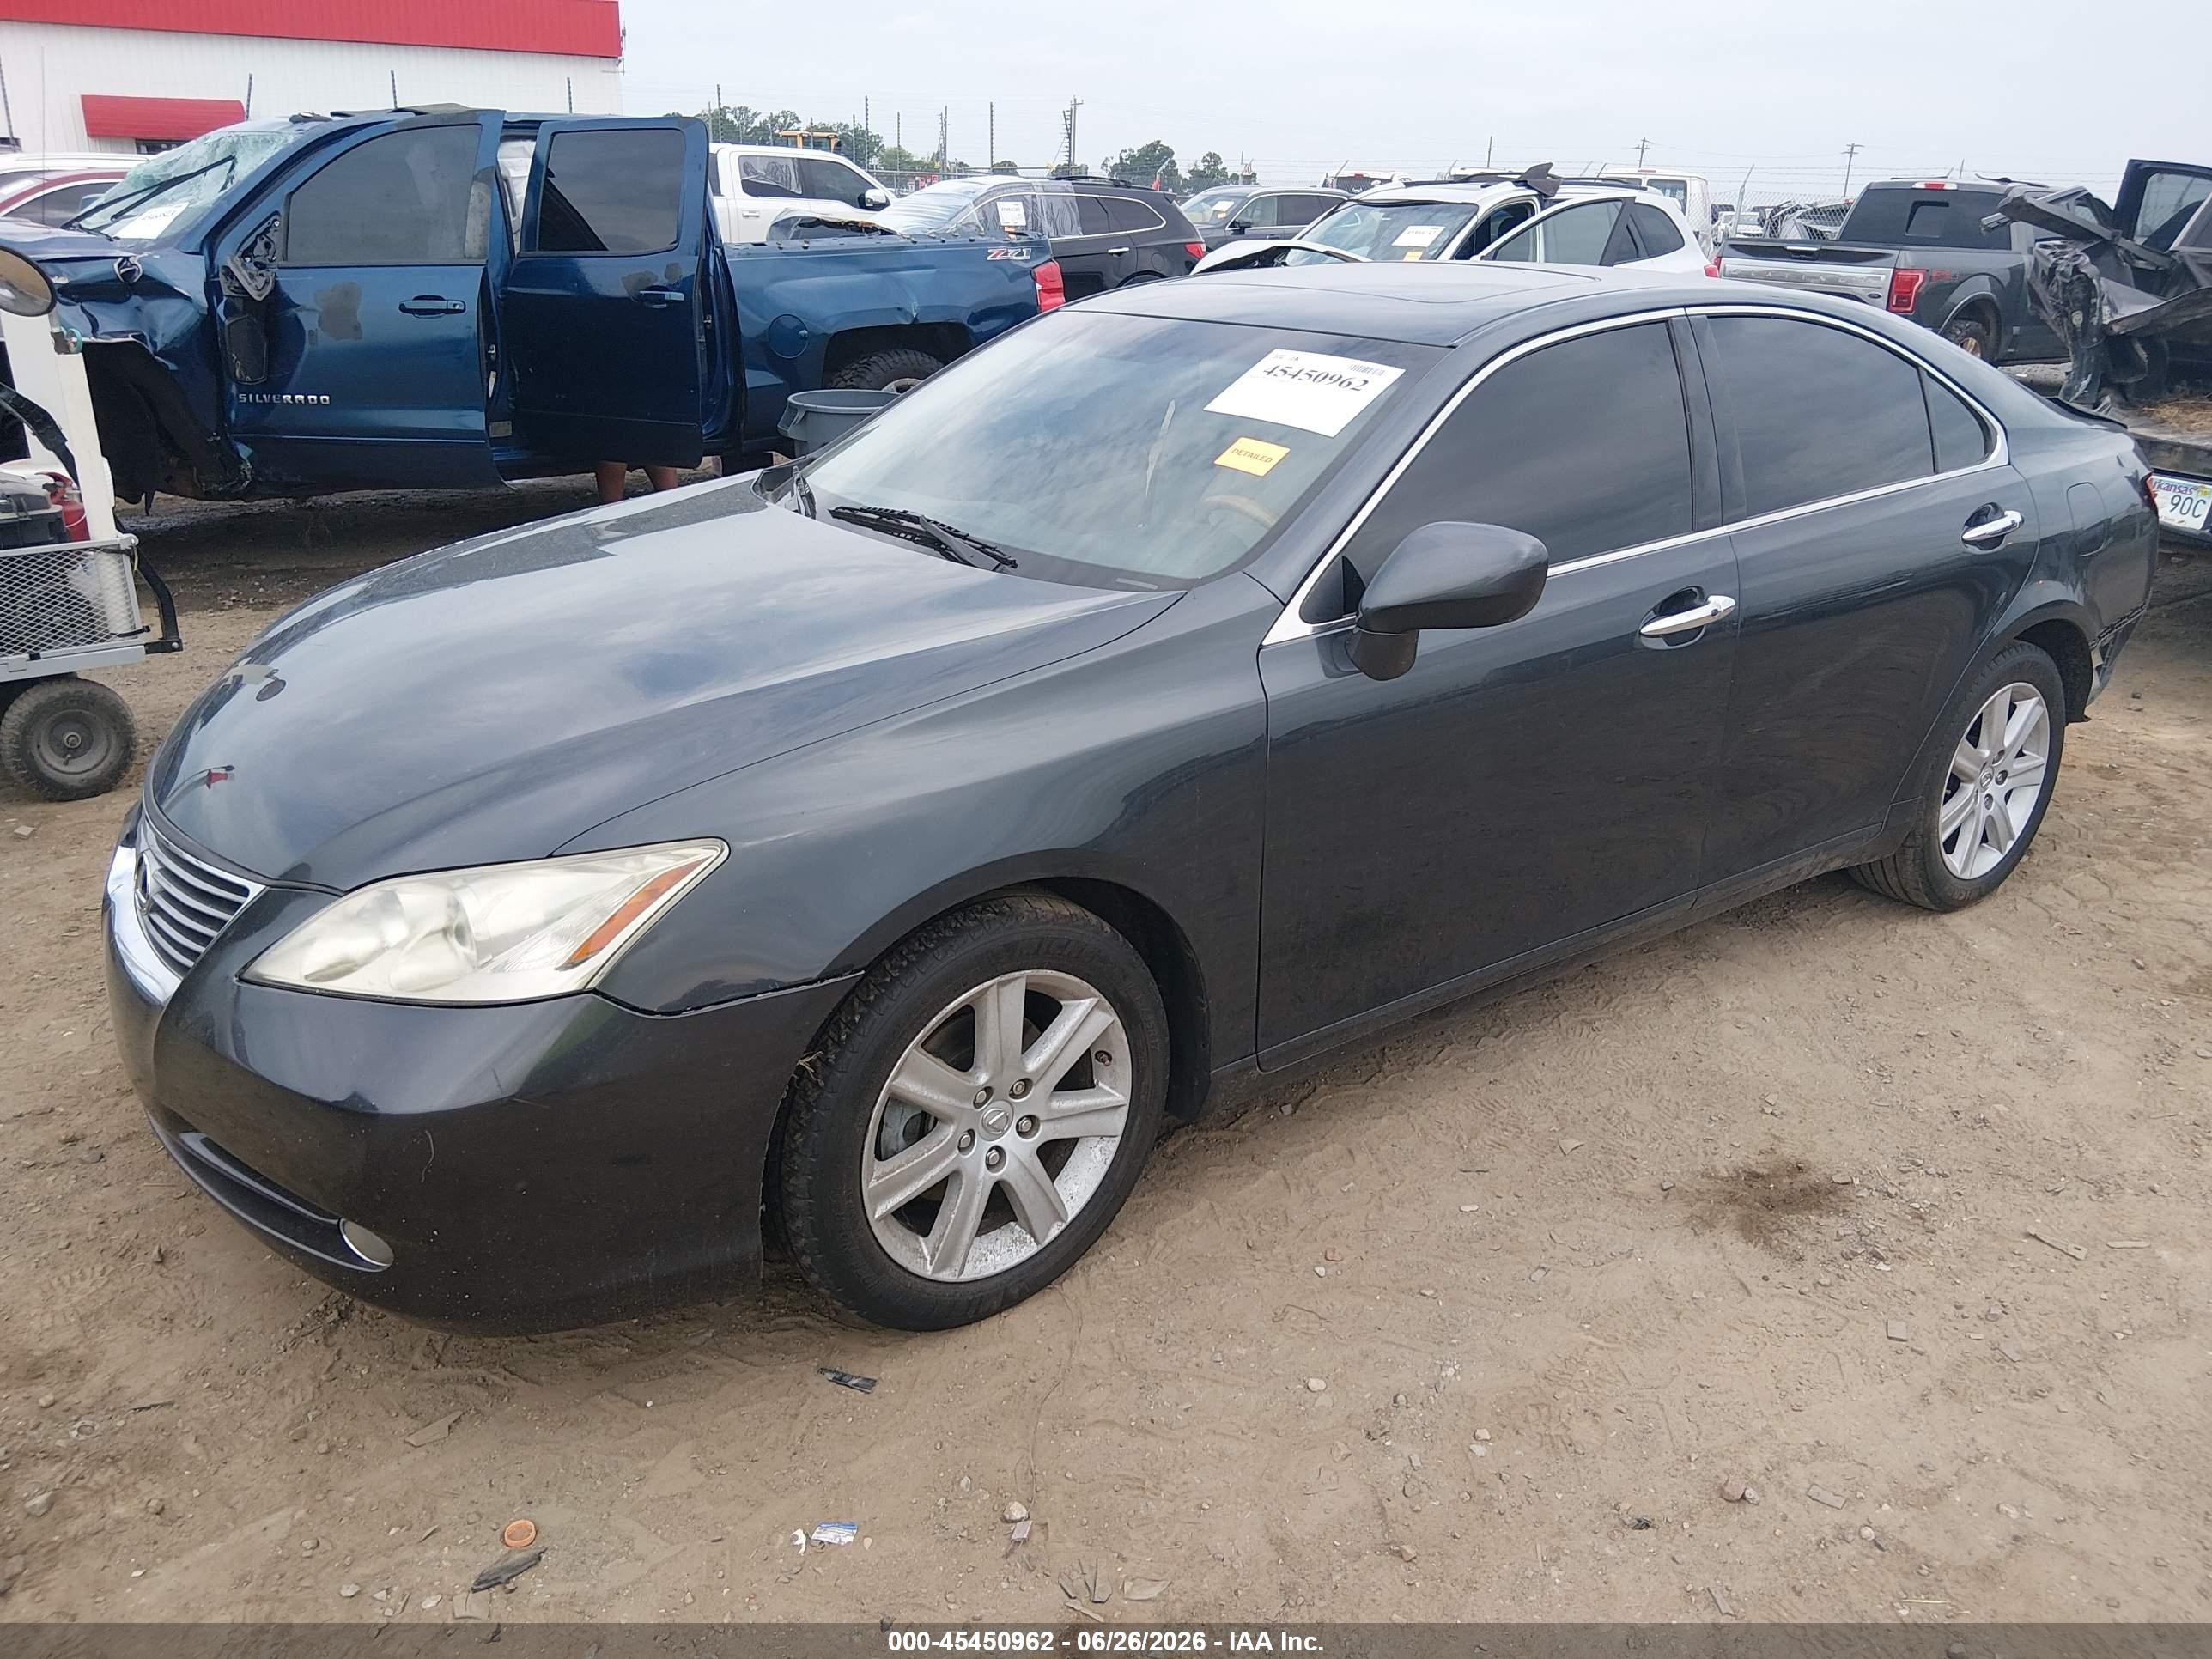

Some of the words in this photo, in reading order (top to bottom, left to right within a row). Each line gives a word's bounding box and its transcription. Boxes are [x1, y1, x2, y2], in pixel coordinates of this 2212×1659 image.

[987, 247, 1031, 261] Z71
[1263, 365, 1369, 391] 45450962
[239, 393, 330, 405] SILVERADO
[1231, 448, 1273, 463] DETAILED
[2153, 480, 2194, 495] rkansas
